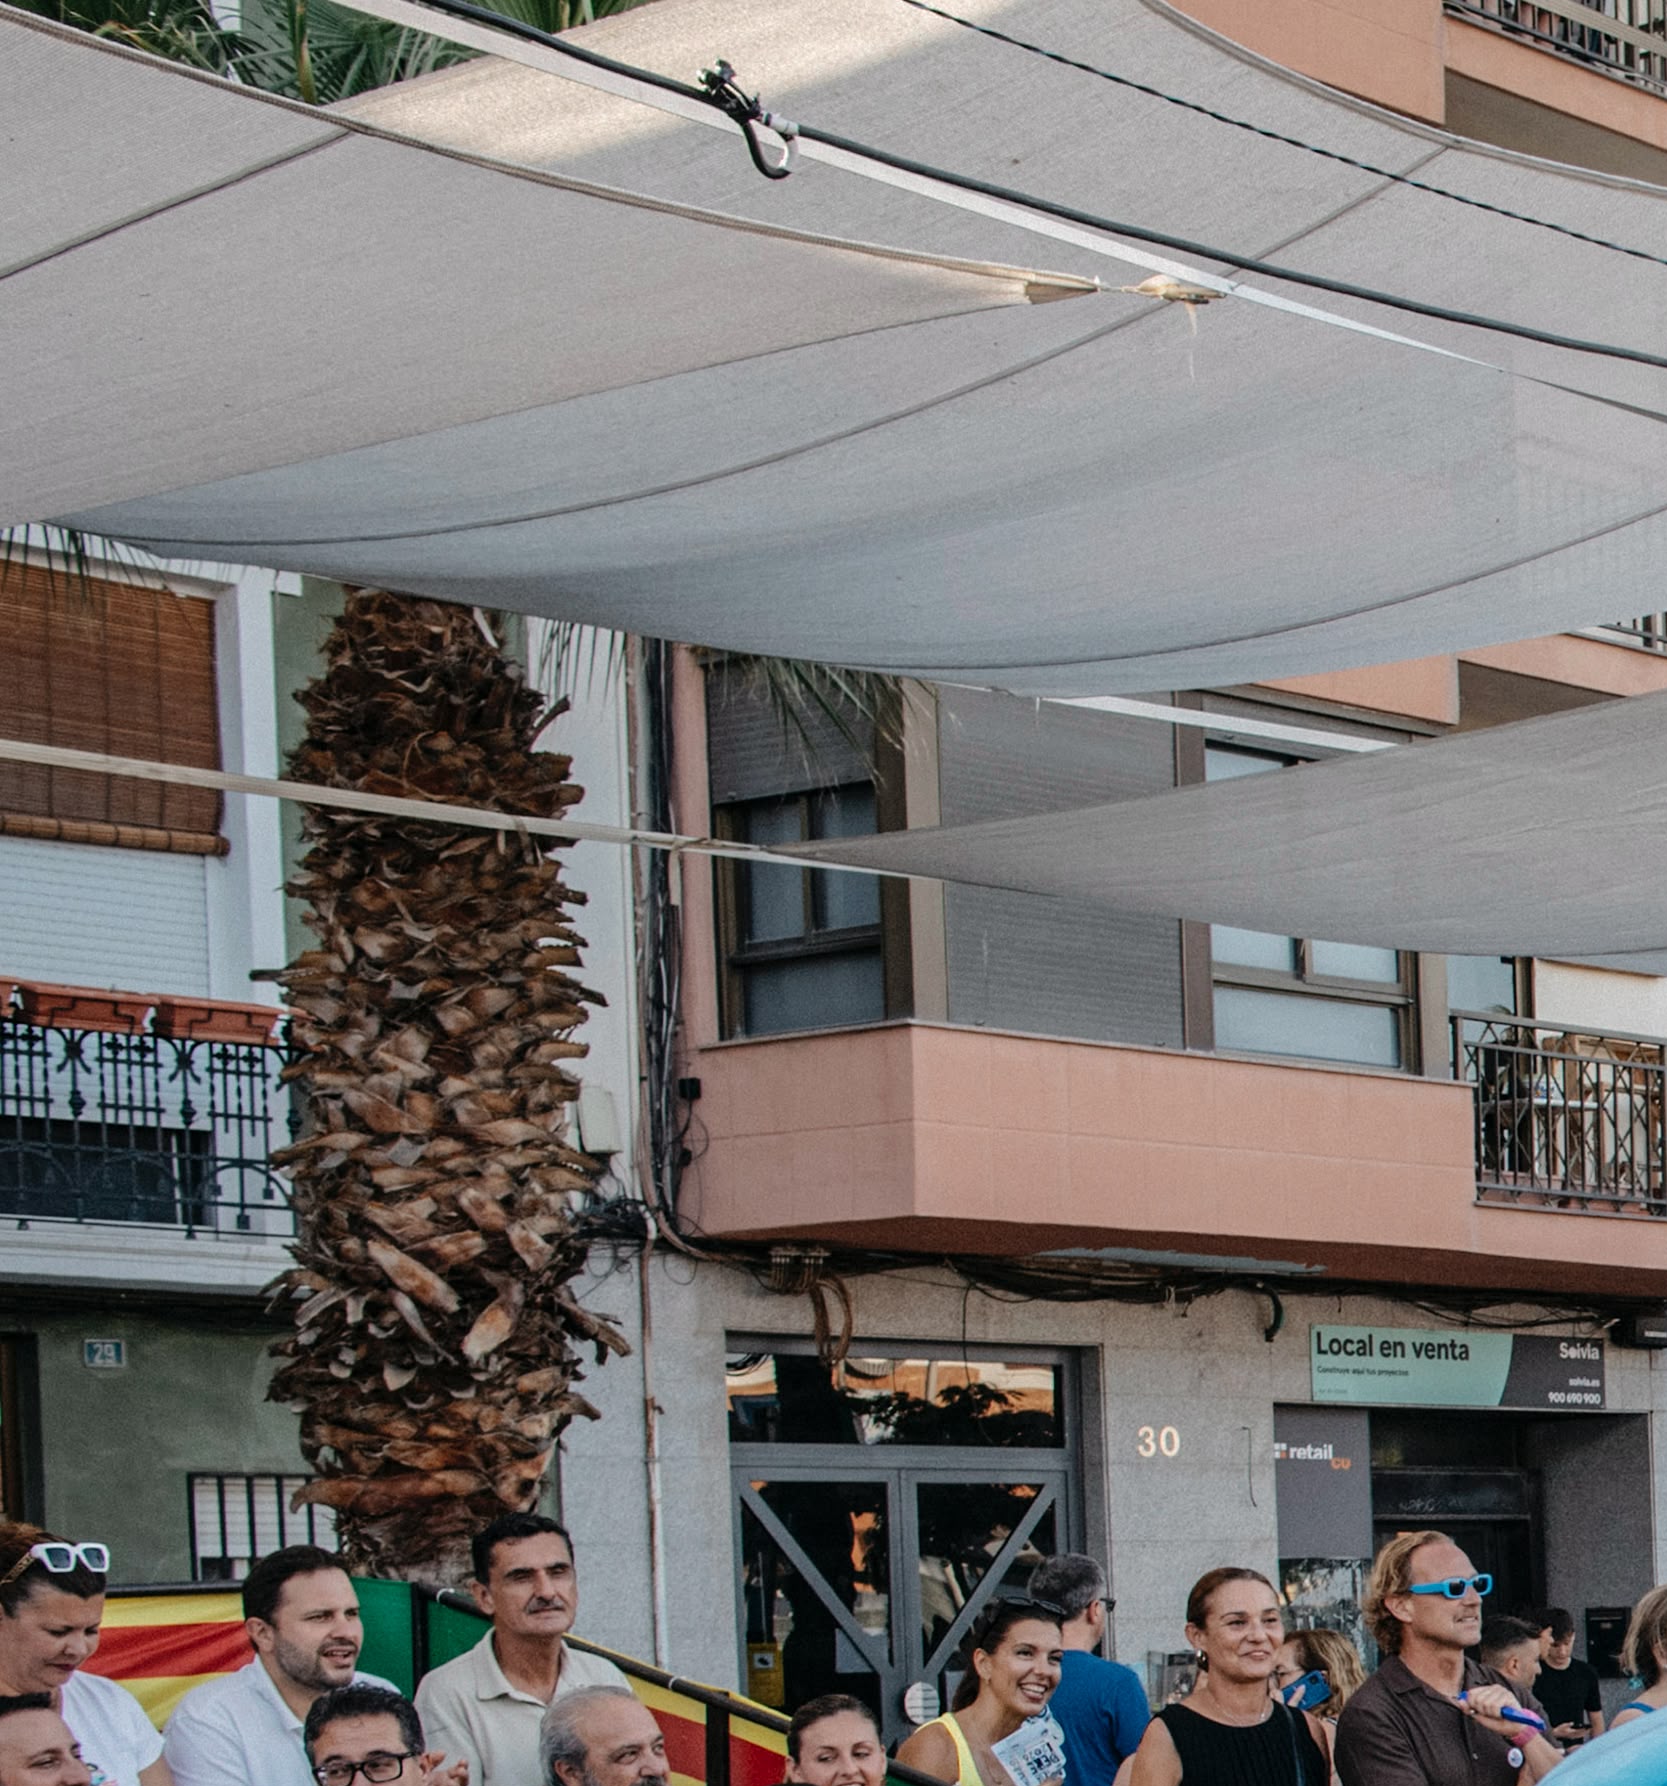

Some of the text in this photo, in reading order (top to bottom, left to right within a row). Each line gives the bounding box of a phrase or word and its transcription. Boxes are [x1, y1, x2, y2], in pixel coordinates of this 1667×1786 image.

[93, 1344, 115, 1364] 29
[1316, 1331, 1470, 1361] Local en venta
[1548, 1392, 1600, 1404] 900 690 900
[1138, 1425, 1180, 1457] 30
[1290, 1443, 1333, 1460] retail
